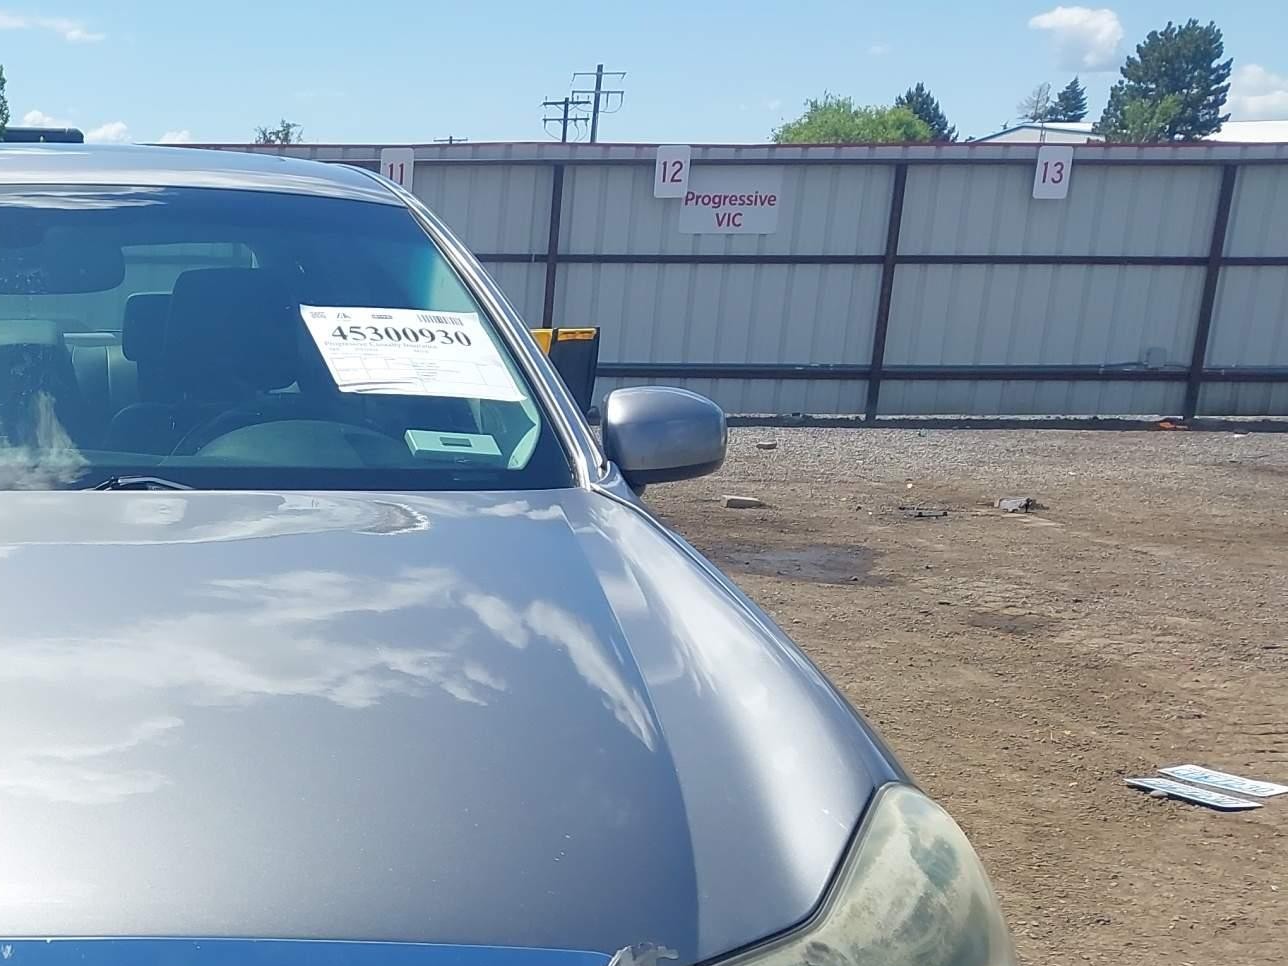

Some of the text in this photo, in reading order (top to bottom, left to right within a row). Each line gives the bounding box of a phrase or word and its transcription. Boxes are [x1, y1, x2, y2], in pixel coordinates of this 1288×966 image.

[388, 162, 404, 186] 11
[662, 160, 684, 183] 12
[1042, 161, 1064, 184] 13
[684, 190, 777, 209] Progressive
[715, 212, 743, 227] VIC
[331, 325, 472, 347] 45300930
